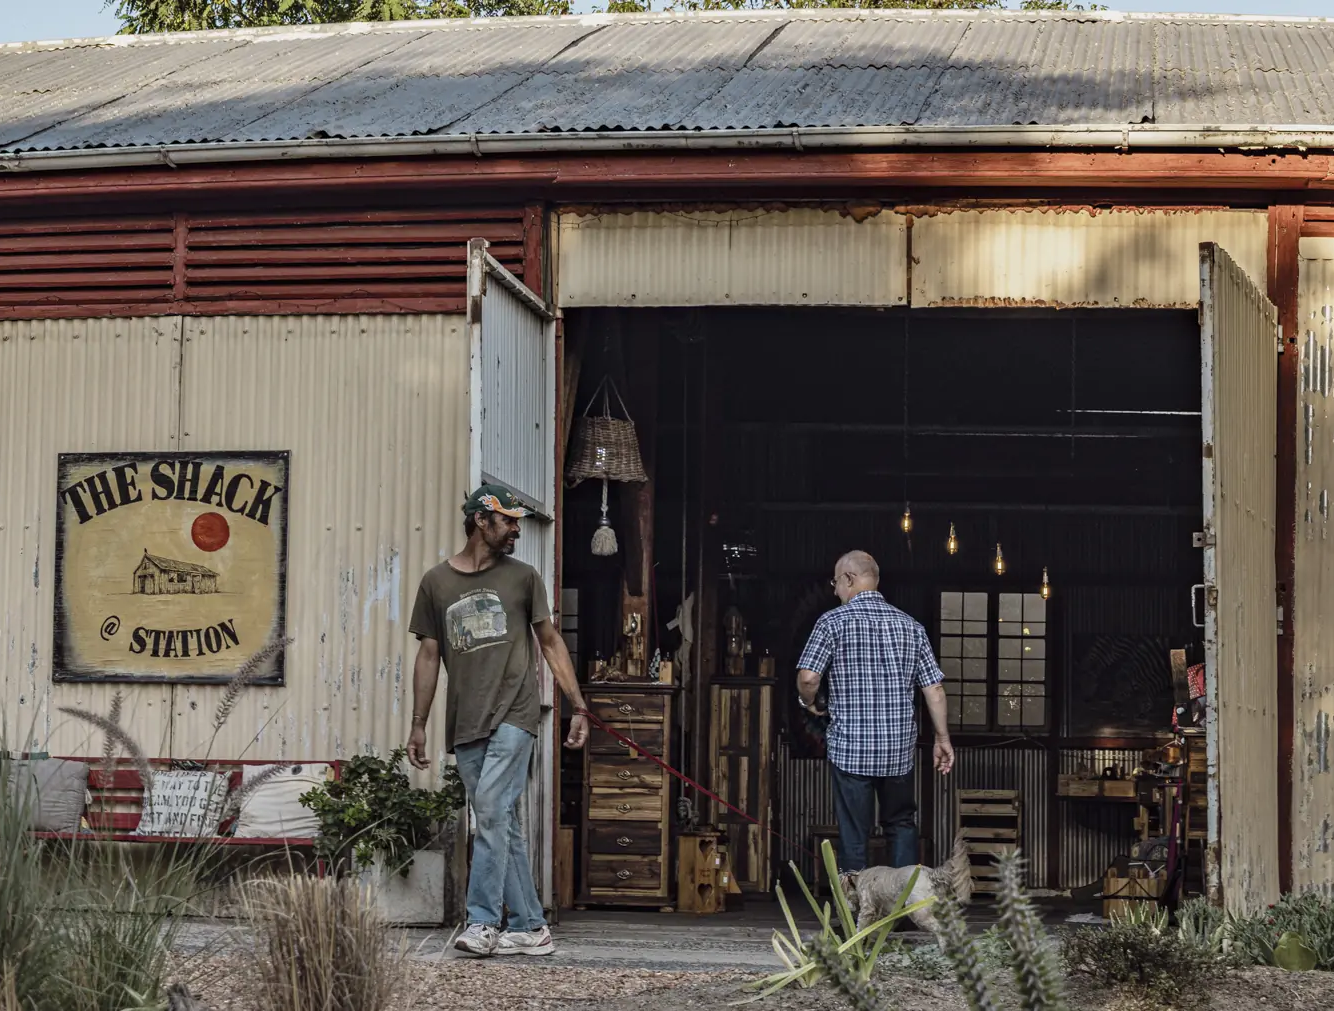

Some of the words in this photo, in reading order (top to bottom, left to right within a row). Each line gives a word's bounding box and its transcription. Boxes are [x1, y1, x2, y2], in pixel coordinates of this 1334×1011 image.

[61, 462, 143, 525] THE
[150, 460, 283, 526] SHACK
[100, 615, 121, 641] @
[128, 618, 240, 658] STATION
[175, 794, 197, 808] YOU
[164, 811, 187, 827] AND
